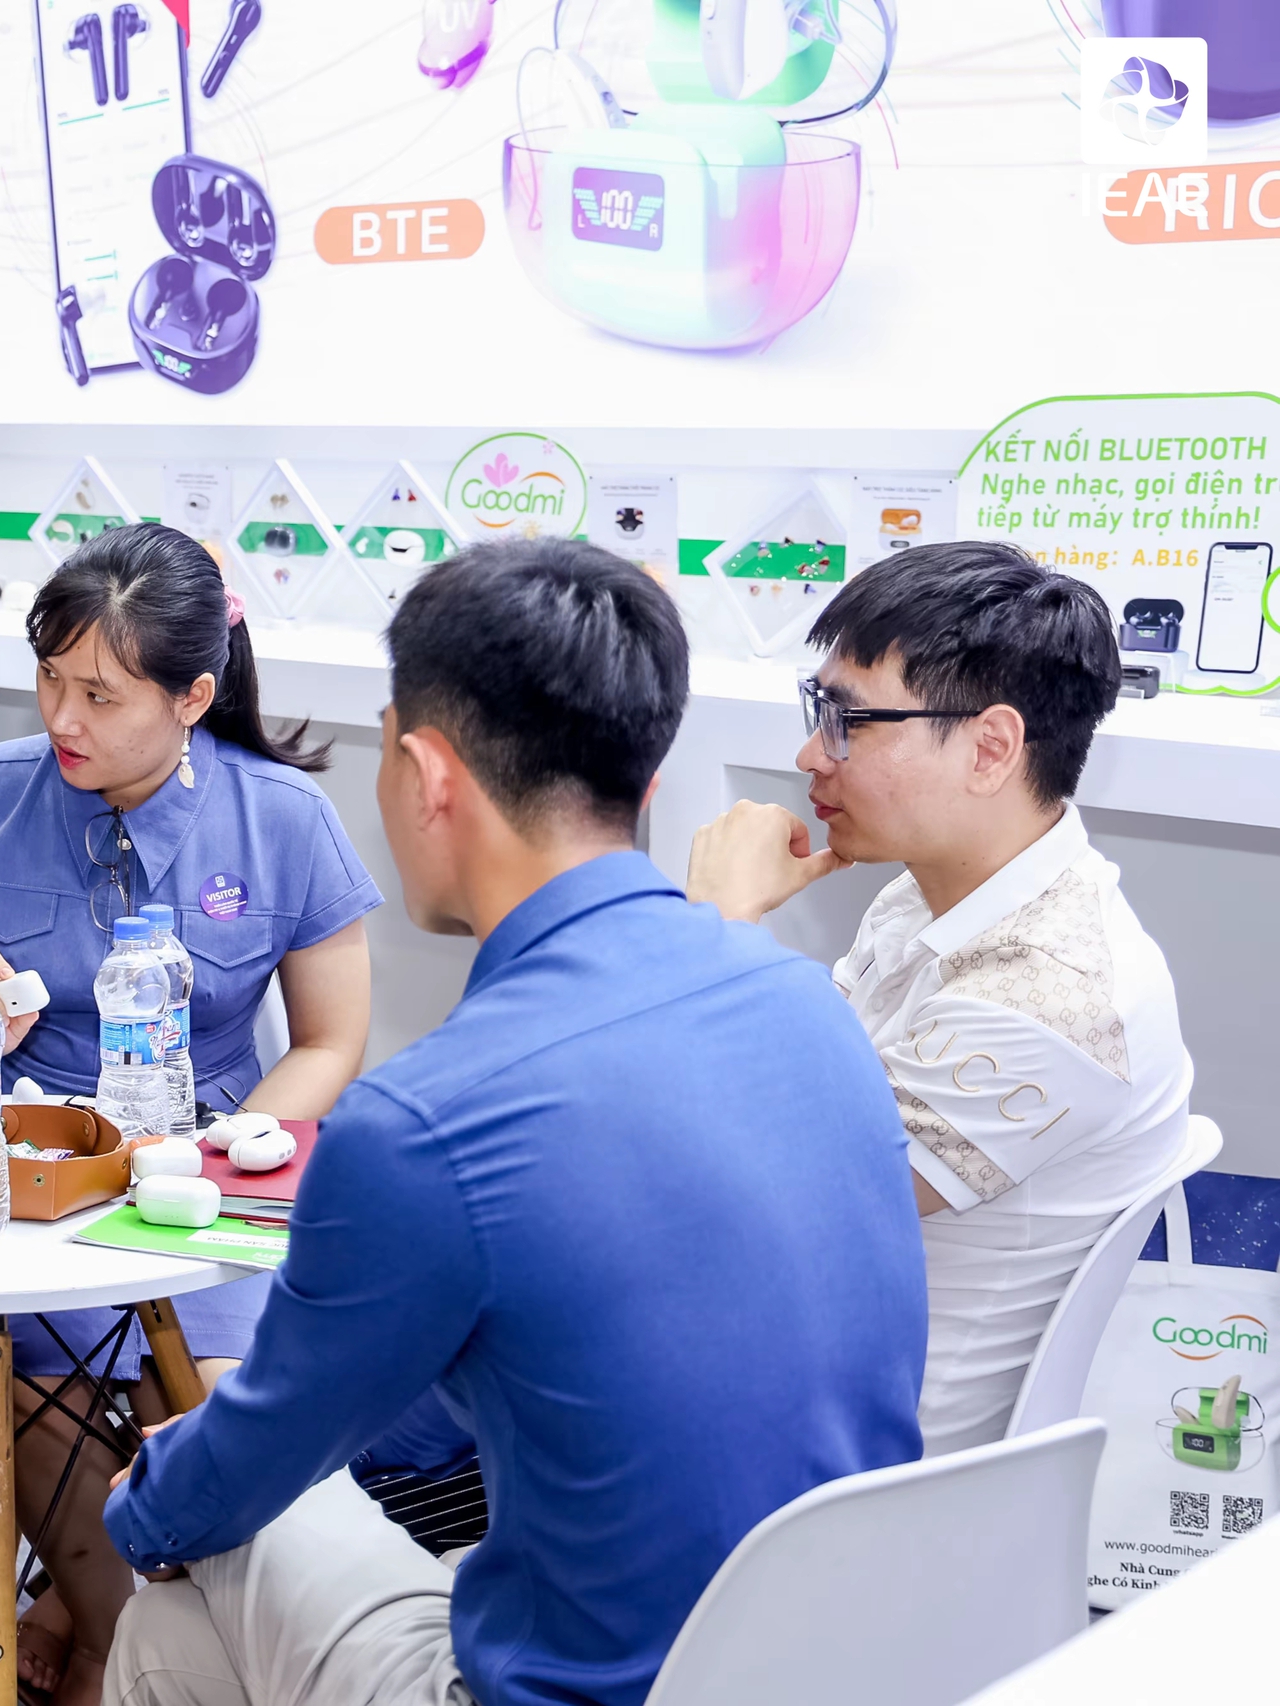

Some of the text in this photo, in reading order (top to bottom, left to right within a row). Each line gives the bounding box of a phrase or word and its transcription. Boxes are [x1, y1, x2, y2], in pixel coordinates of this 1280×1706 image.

[601, 189, 634, 230] 100
[352, 207, 449, 257] BTE
[984, 428, 1268, 462] KẾT NỐI BLUETOOTH
[461, 478, 565, 516] Goodmi
[980, 469, 1280, 504] Nghe nhạc, gọi điện tr
[1032, 503, 1060, 528] từ
[1068, 503, 1123, 535] máy
[1132, 506, 1173, 536] trợ
[1181, 503, 1261, 530] thính!
[1054, 544, 1118, 571] hàng:
[1131, 548, 1200, 568] A.B16
[206, 887, 242, 903] VISITOR
[907, 1020, 1070, 1140] UCCI
[1152, 1317, 1268, 1354] Goodmi
[1104, 1541, 1218, 1558] www.goodmihear
[1112, 1577, 1128, 1588] Có
[1120, 1562, 1145, 1574] Nhà
